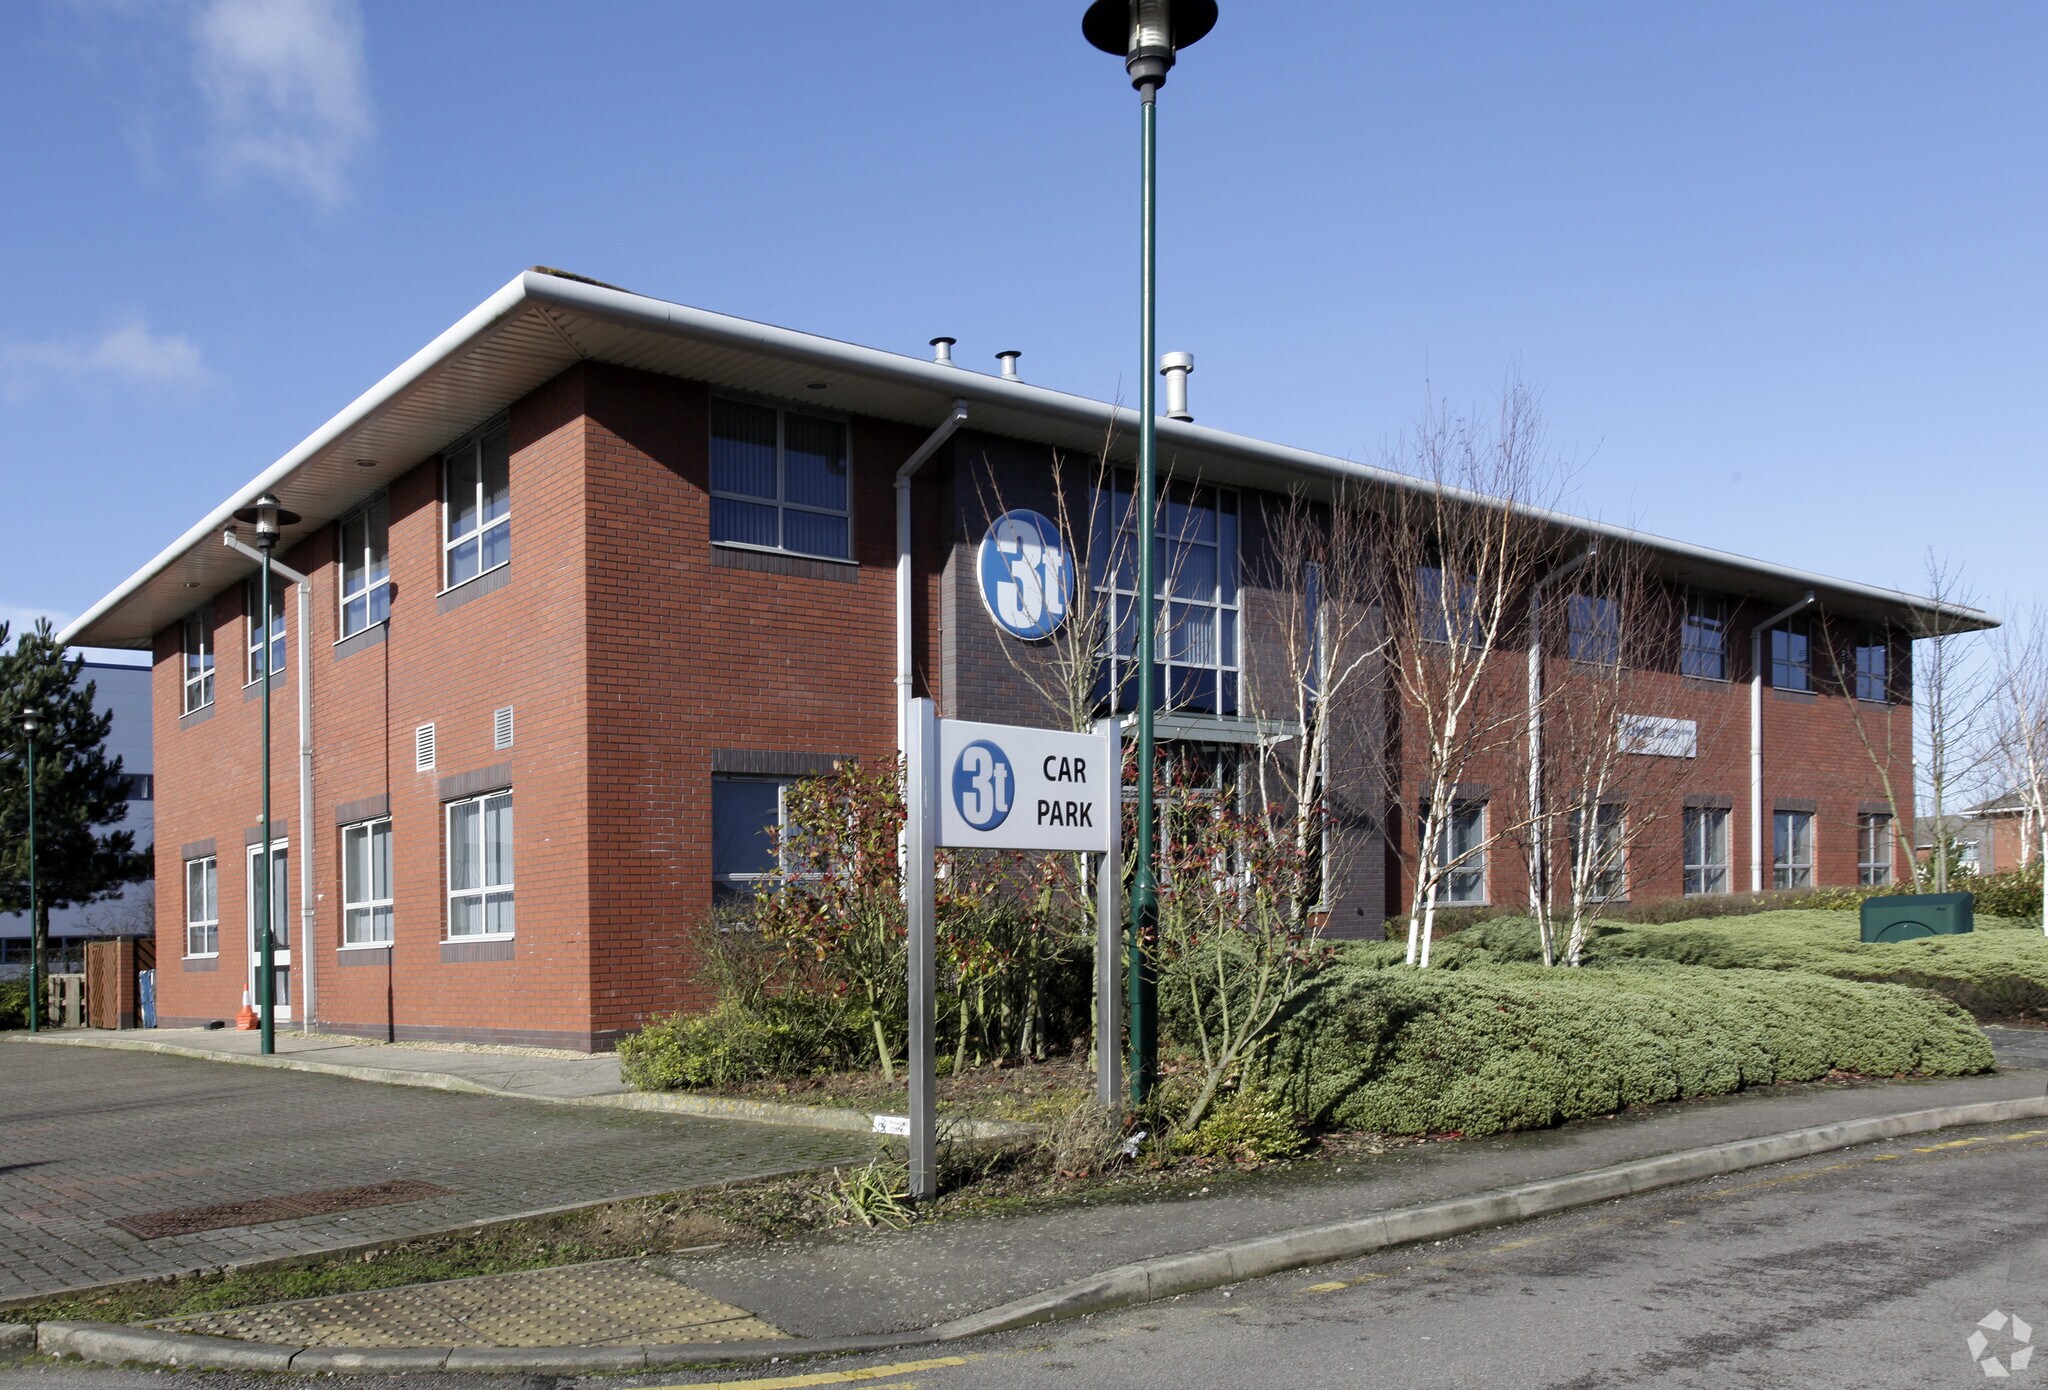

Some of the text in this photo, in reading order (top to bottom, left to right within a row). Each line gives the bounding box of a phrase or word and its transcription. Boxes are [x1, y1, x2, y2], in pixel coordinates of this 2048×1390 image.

[997, 519, 1064, 629] 3t
[962, 746, 1008, 825] 3t
[1043, 755, 1086, 783] CAR
[1037, 799, 1093, 827] PARK
